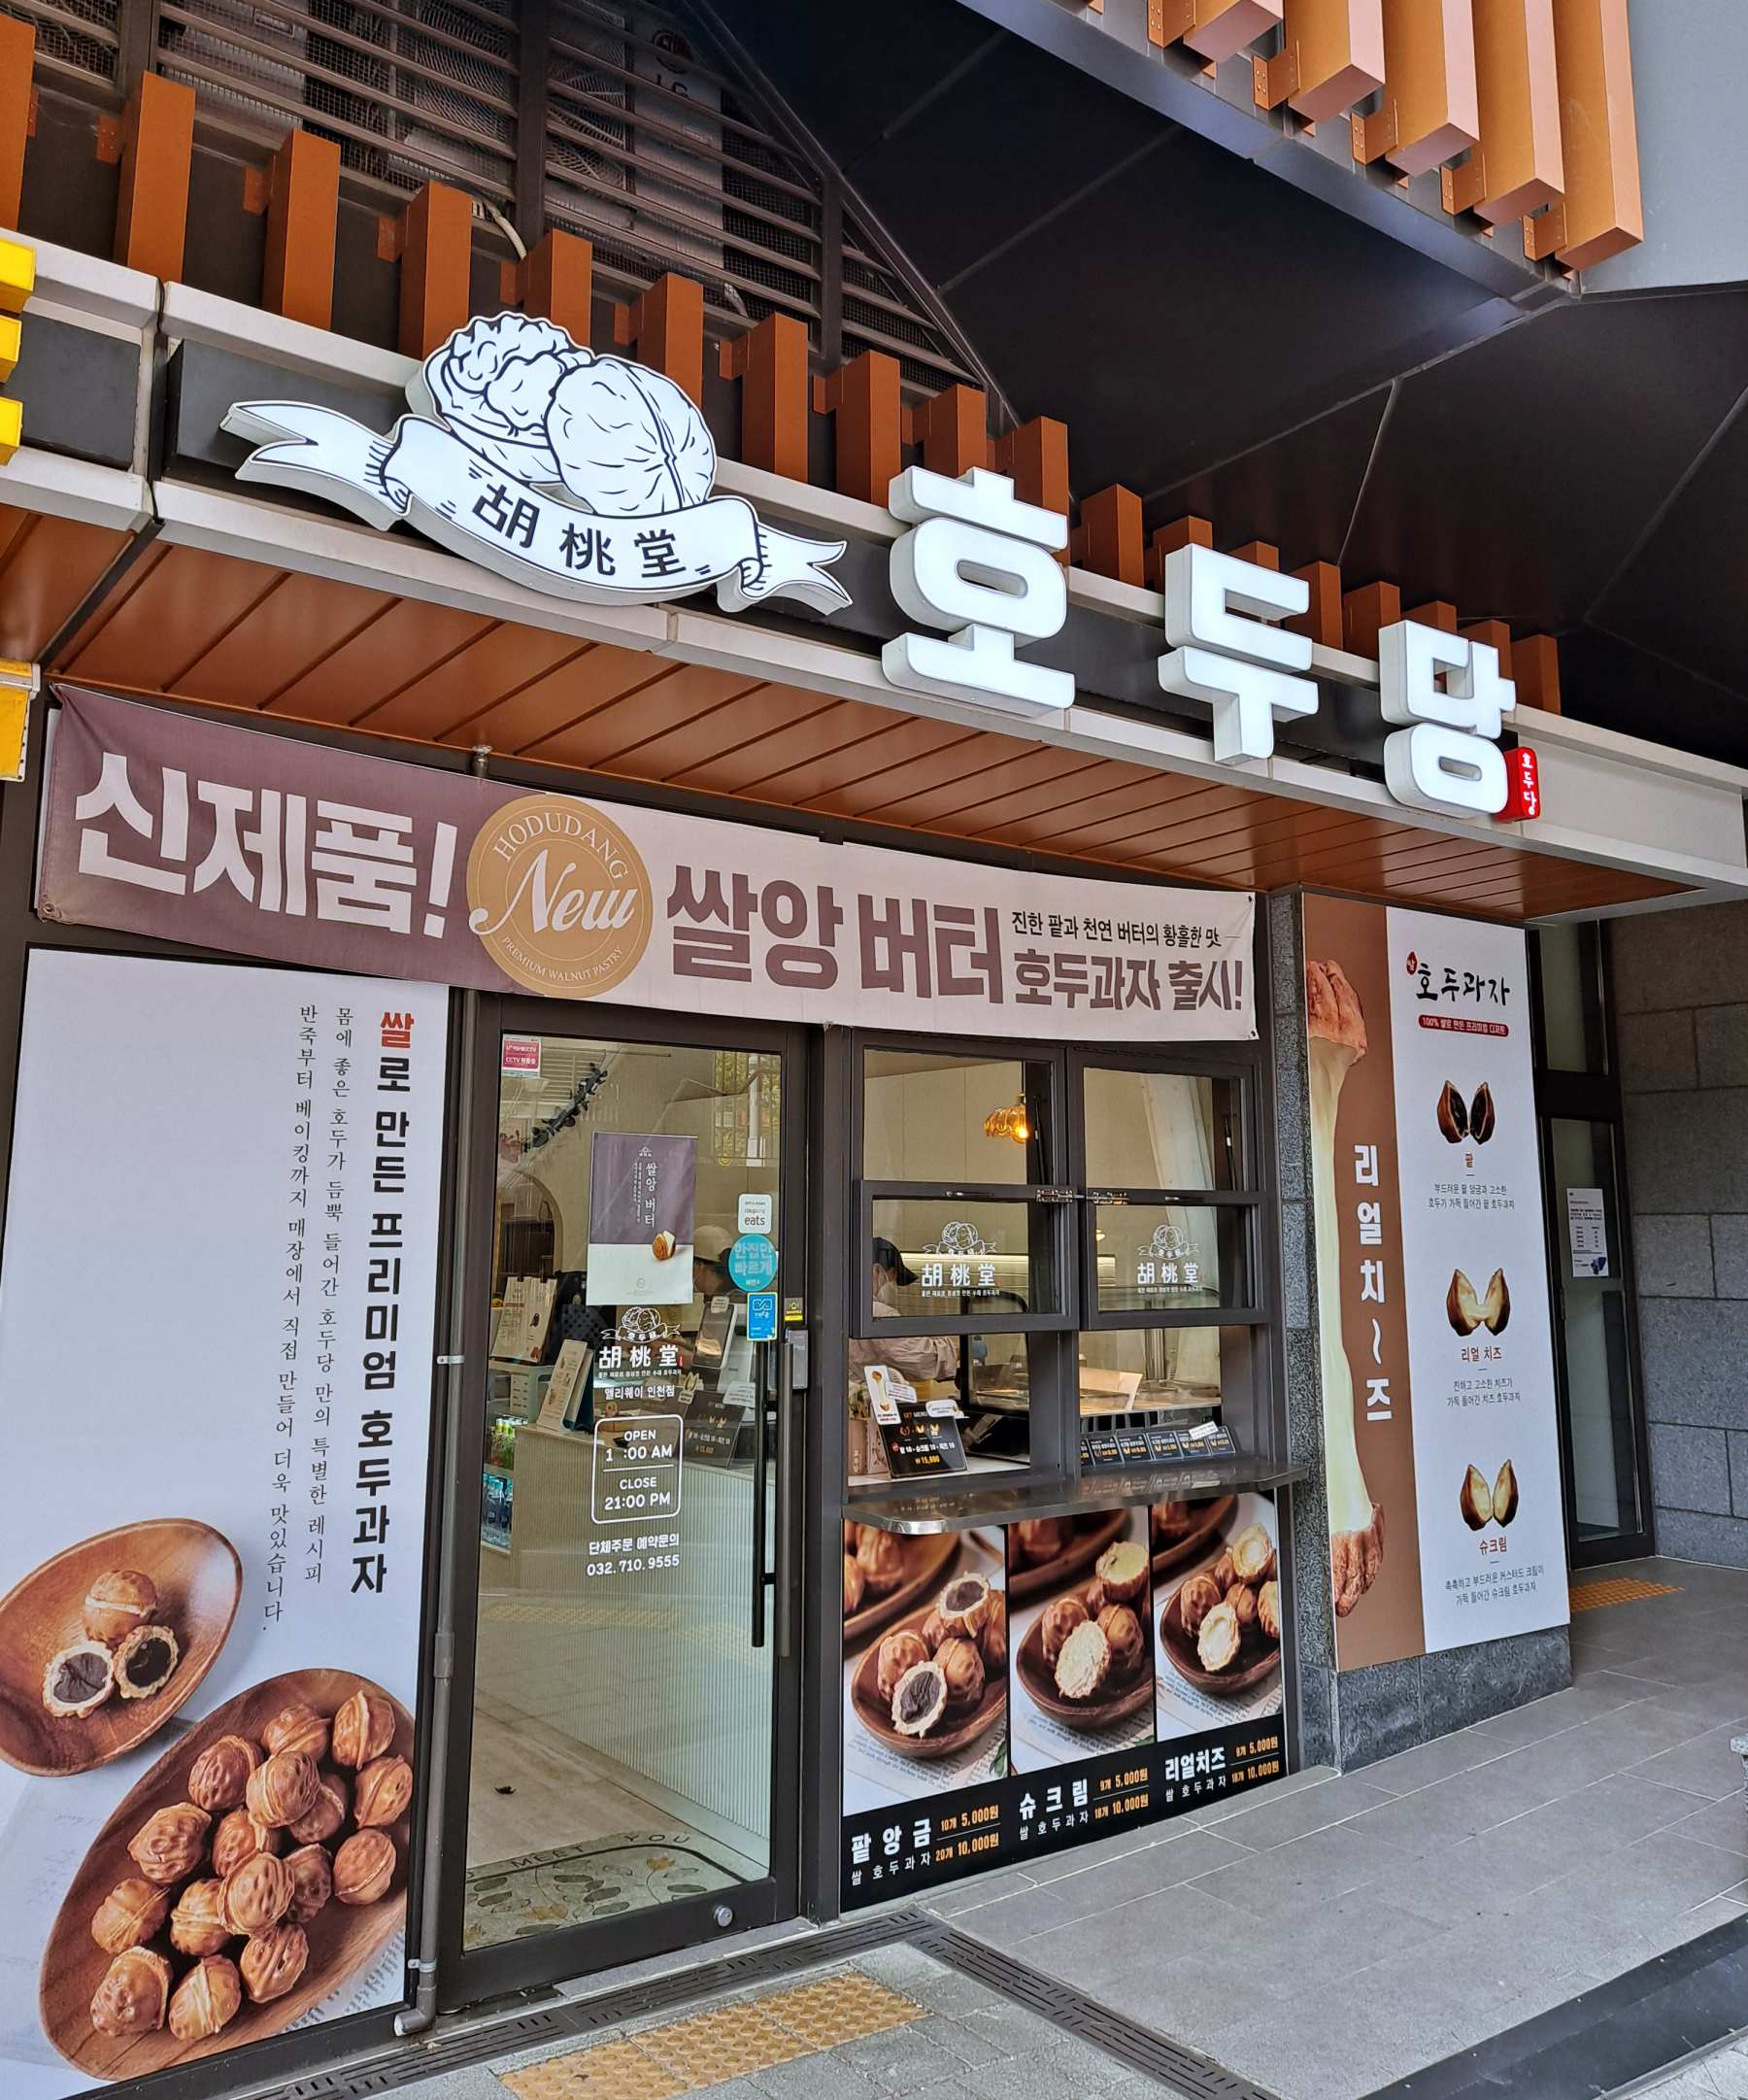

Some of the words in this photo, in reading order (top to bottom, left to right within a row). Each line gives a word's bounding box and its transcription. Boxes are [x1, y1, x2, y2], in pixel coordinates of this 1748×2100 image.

[473, 484, 687, 577] 胡桃堂
[883, 465, 1516, 818] 호두당
[1522, 752, 1537, 815] 호두당
[75, 754, 459, 939] 신제품!
[492, 811, 629, 880] HODUDANG
[468, 848, 639, 935] New
[1011, 910, 1043, 936] 진한
[1048, 914, 1079, 939] 팥과
[1083, 918, 1114, 942] 천연
[1117, 921, 1160, 946] 버터의
[1162, 924, 1202, 949] 황홀한
[1205, 927, 1223, 949] 맛
[501, 935, 547, 976] PREMIUM
[548, 966, 594, 982] WALNUT
[591, 945, 623, 976] PASTRY
[1014, 948, 1161, 1011] 호두과자
[1167, 959, 1243, 1011] 출시!
[1416, 963, 1510, 1006] 호두과자
[296, 1004, 319, 1090] 반죽부터
[335, 1006, 353, 1049] 몸에
[1422, 1017, 1439, 1028] 100%
[1465, 1021, 1489, 1033] 프리미엄
[1489, 1024, 1506, 1035] 디저트
[377, 1011, 415, 1092] 쌀로
[331, 1057, 352, 1099] 좋은
[288, 1099, 313, 1208] 베이킹까지
[327, 1108, 349, 1172] 호두가
[372, 1110, 410, 1193] 만든
[323, 1180, 345, 1223] 듬뿍
[644, 1197, 656, 1229] 버터
[744, 1215, 765, 1226] eats
[283, 1218, 306, 1307] 매장에서
[319, 1233, 342, 1298] 들어간
[922, 1263, 996, 1288] 胡桃堂
[1137, 1262, 1199, 1284] 胡桃堂
[362, 1213, 403, 1391] 프리미엄
[280, 1316, 300, 1361] 직접
[598, 1344, 679, 1370] 胡桃堂
[1461, 1346, 1480, 1363] 리얼
[1483, 1345, 1502, 1361] 치즈
[276, 1370, 297, 1439] 만들어
[647, 1385, 675, 1398] 인천점
[623, 1430, 656, 1441] OPEN
[652, 1444, 673, 1459] AM
[271, 1448, 291, 1494] 더욱
[309, 1437, 330, 1506] 특별한
[620, 1476, 657, 1490] CLOSE
[350, 1409, 393, 1594] 호두과자
[604, 1494, 646, 1510] 21:00
[650, 1491, 671, 1507] PM
[304, 1515, 325, 1585] 레시피
[588, 1538, 633, 1555] 단체주문
[636, 1533, 680, 1550] 예약문의
[1479, 1535, 1507, 1555] 슈크림
[262, 1504, 290, 1632] 맛있습니다.
[1164, 1746, 1227, 1782] 리얼치즈
[940, 1816, 958, 1832] 10개
[935, 1846, 954, 1862] 20개
[851, 1868, 862, 1886] 쌀
